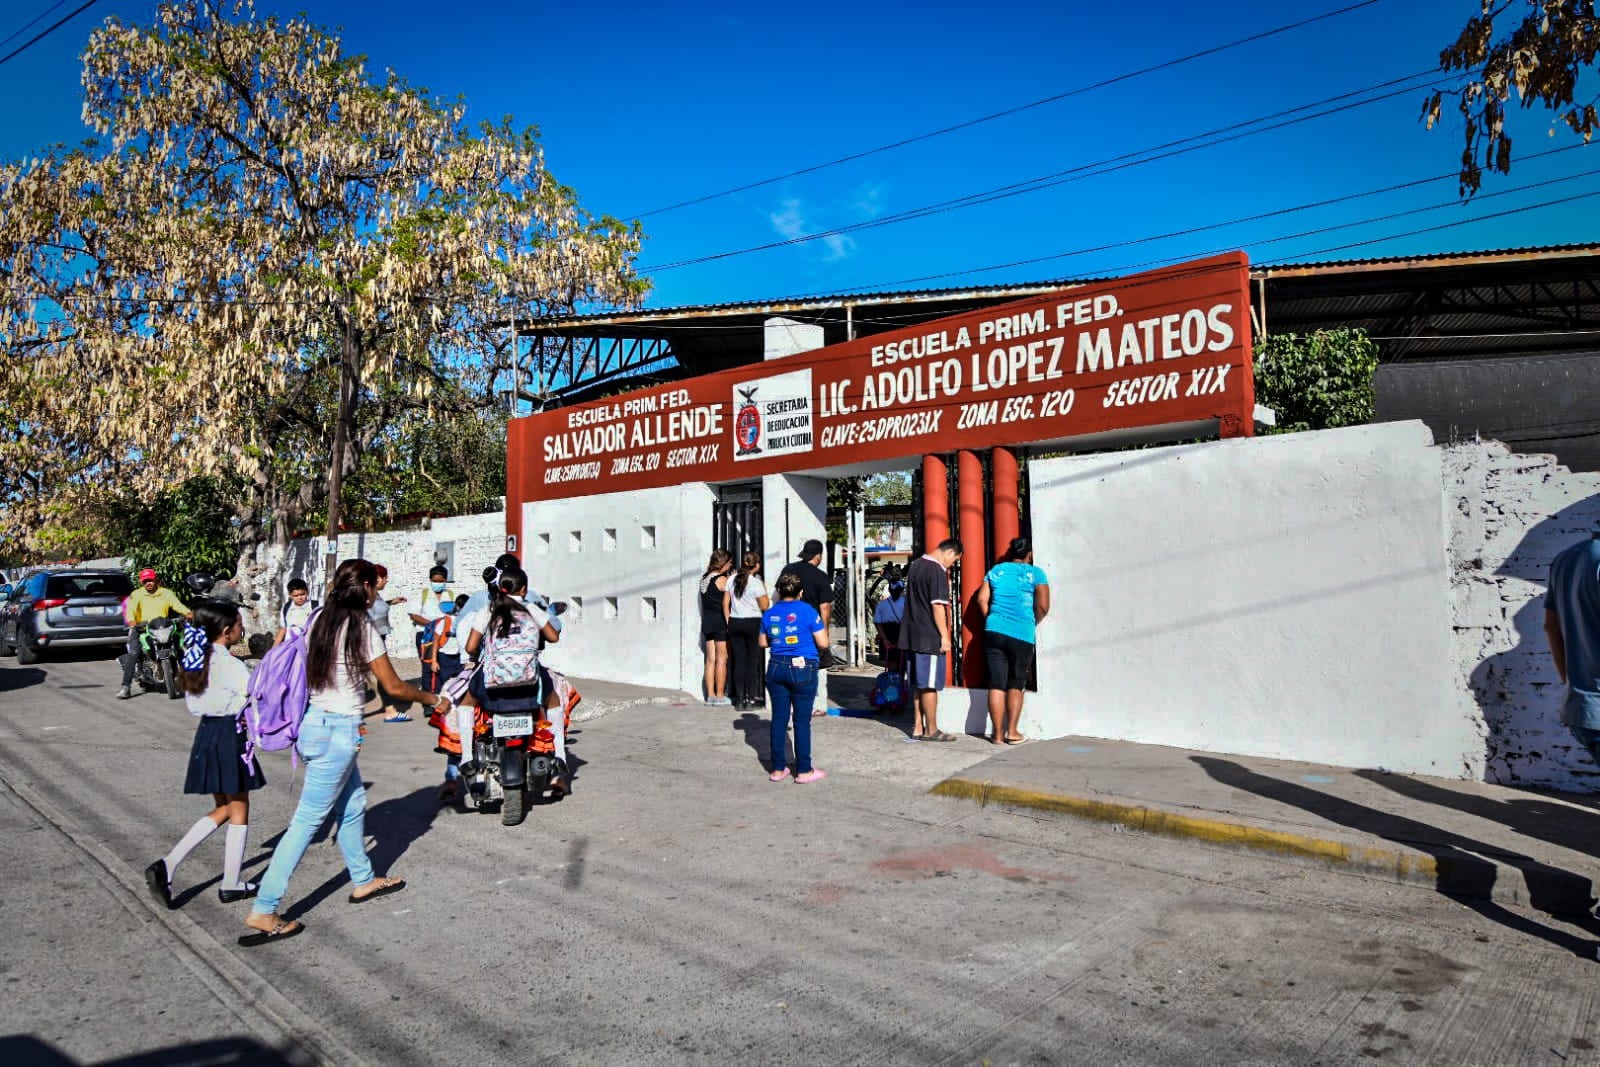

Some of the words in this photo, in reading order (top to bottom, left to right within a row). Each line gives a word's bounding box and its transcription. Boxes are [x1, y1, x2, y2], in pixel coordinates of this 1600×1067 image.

[871, 326, 972, 367] ESCUELA
[979, 308, 1051, 345] PRIM.
[1056, 294, 1124, 329] FED.
[820, 379, 858, 418] LIC.
[861, 357, 963, 411] ADOLFO
[971, 336, 1065, 392] LOPEZ
[1075, 303, 1235, 375] MATEOS
[568, 403, 622, 428] ESCUELA
[624, 395, 659, 418] PRIM.
[660, 388, 692, 410] FED.
[767, 396, 809, 416] SECRETARIA
[957, 400, 999, 430] ZONA
[1001, 395, 1035, 423] ESC.
[1039, 388, 1075, 418] 120
[1103, 372, 1181, 408] SECTOR
[1184, 363, 1232, 398] XIX
[544, 422, 627, 463] SALVADOR
[630, 403, 724, 449] ALLENDE
[767, 421, 774, 432] DE
[774, 415, 810, 432] EDUCACION
[610, 457, 631, 476] ZONA
[629, 454, 645, 473] ESC.
[645, 452, 661, 471] 120
[665, 447, 698, 469] SECTOR
[698, 443, 721, 464] XIX
